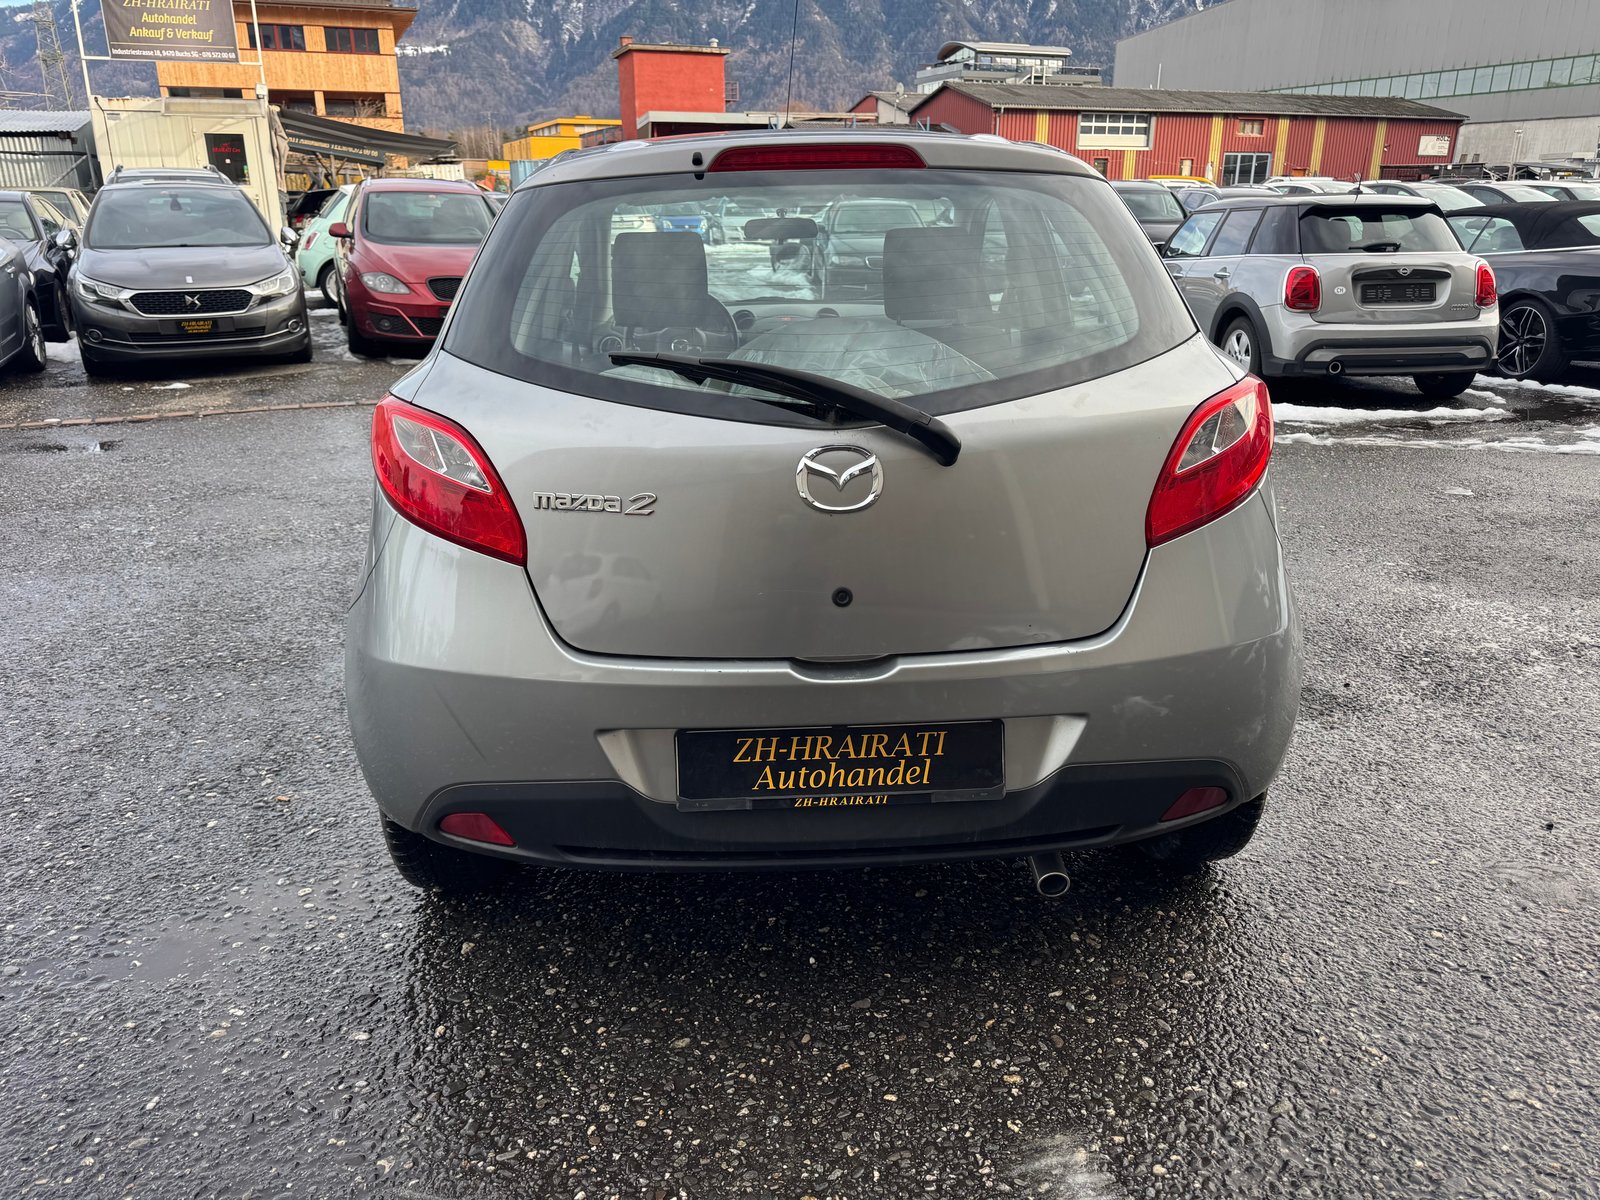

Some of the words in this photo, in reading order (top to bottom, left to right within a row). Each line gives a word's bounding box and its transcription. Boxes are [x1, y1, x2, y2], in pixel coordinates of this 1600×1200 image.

[123, 0, 210, 11] ZH-HRAIRATI
[141, 12, 198, 25] Autohandel
[129, 26, 165, 41] Ankauf
[166, 28, 174, 39] &
[175, 28, 214, 43] Verkauf
[624, 492, 658, 516] 2
[732, 731, 949, 763] ZH-HRAIRATI
[752, 759, 931, 791] Autohandel
[794, 795, 888, 808] ZH-HRAIRATI
